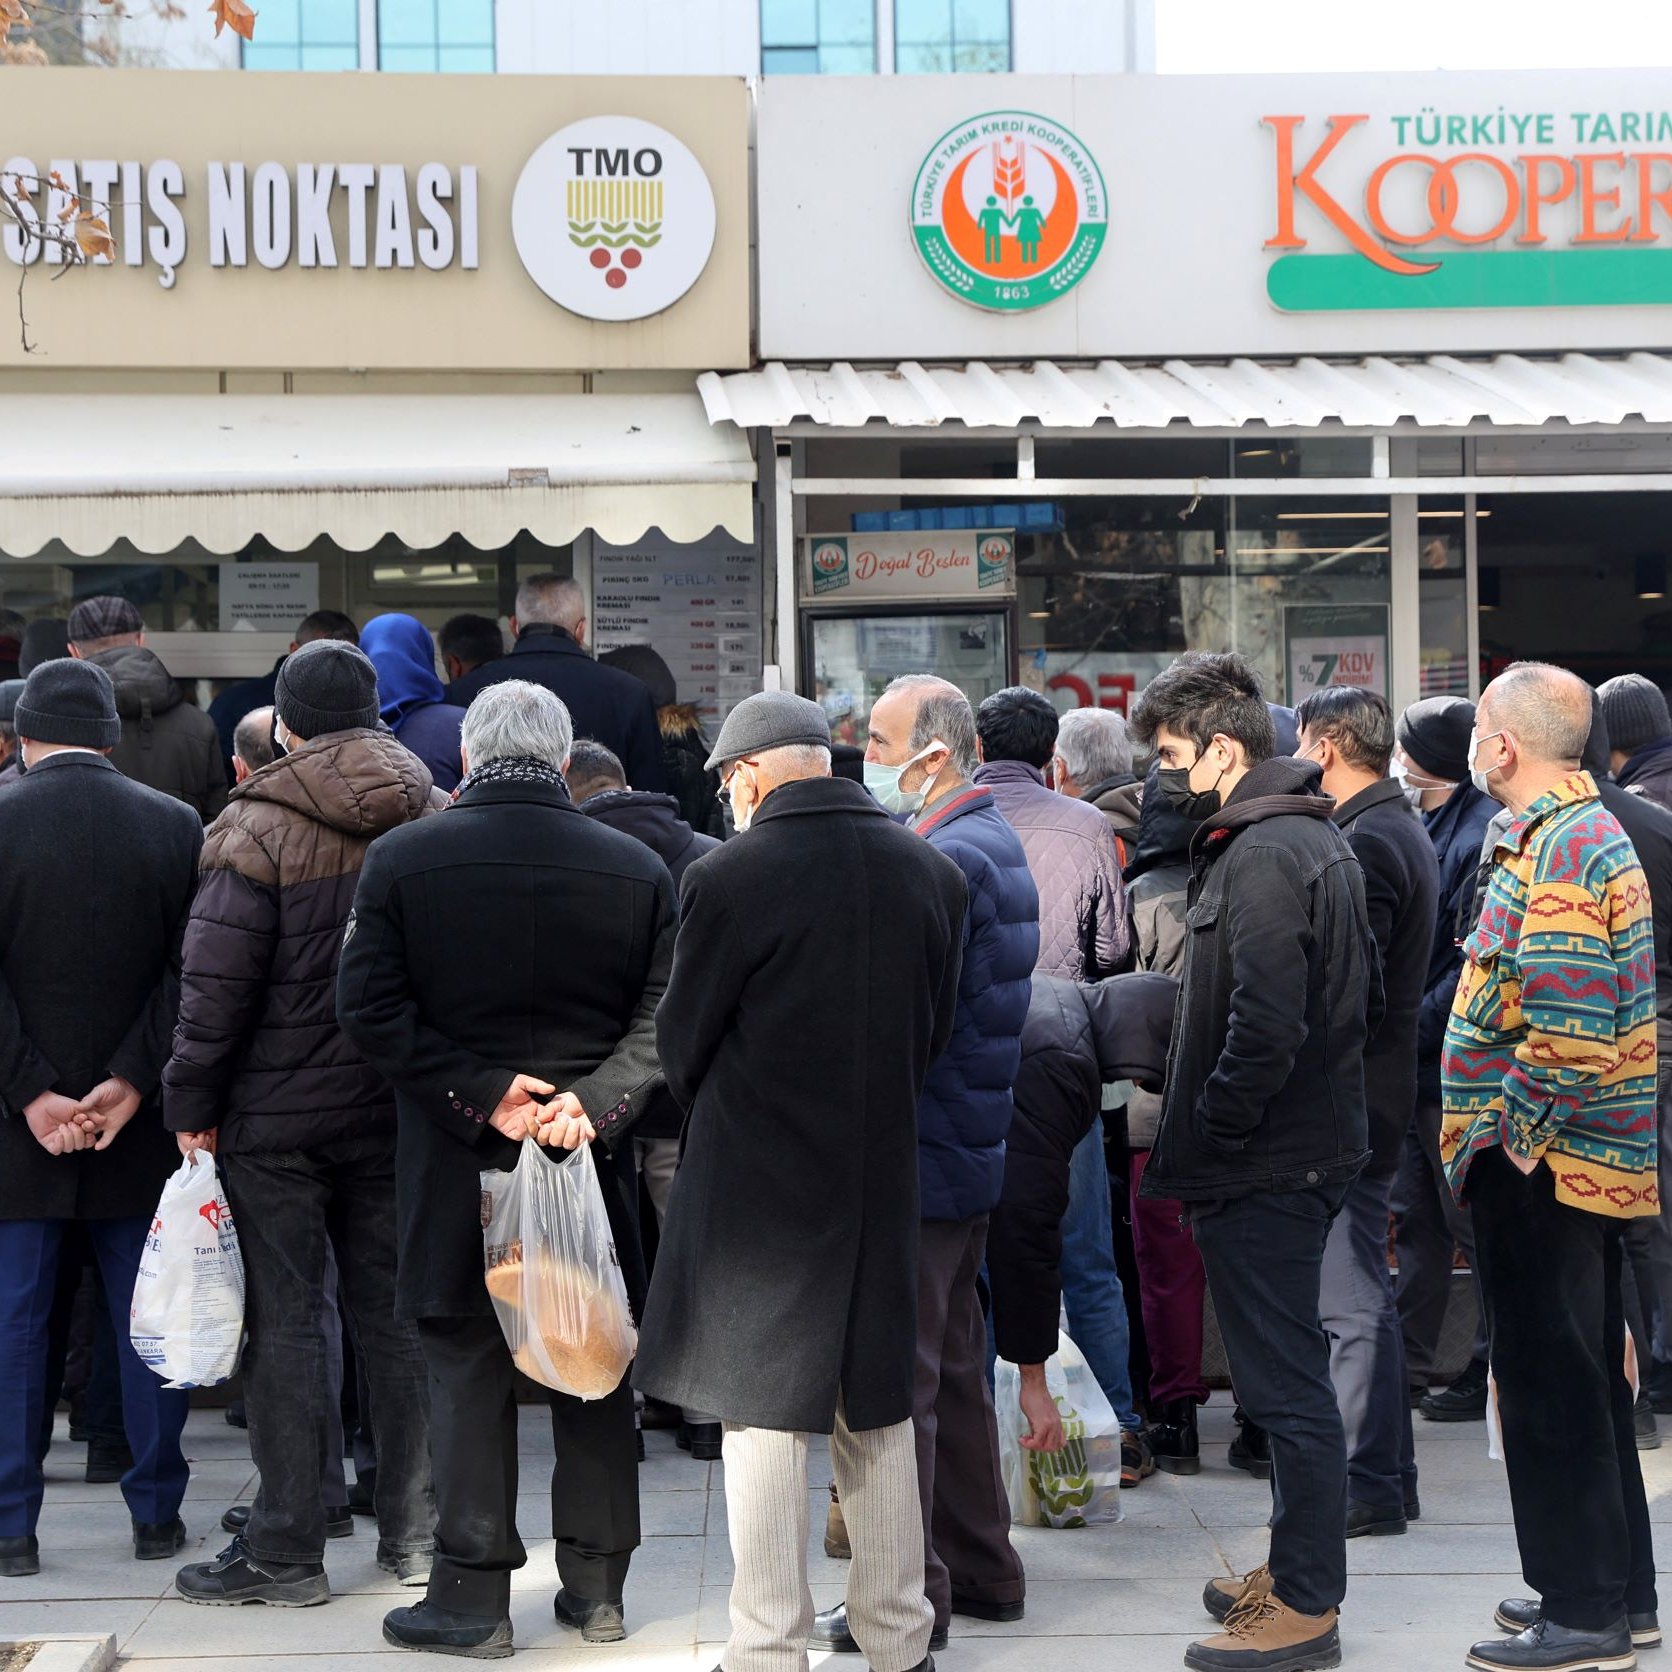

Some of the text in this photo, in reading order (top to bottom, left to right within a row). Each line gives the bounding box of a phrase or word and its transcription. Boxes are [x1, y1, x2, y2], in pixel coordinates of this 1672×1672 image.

[1391, 106, 1554, 146] TÜRKİYE
[567, 147, 663, 177] TMO
[921, 120, 1100, 219] TÜRKİYE TARIM KREDİ KOOPERATİFLERİ
[1259, 113, 1672, 277] KOOPER
[1, 156, 479, 289] SATIŞ NOKTASI
[994, 286, 1031, 300] 1863
[663, 573, 717, 586] PERLA
[855, 550, 912, 581] Doğal
[916, 547, 971, 578] Beslen
[1339, 652, 1375, 673] KDV
